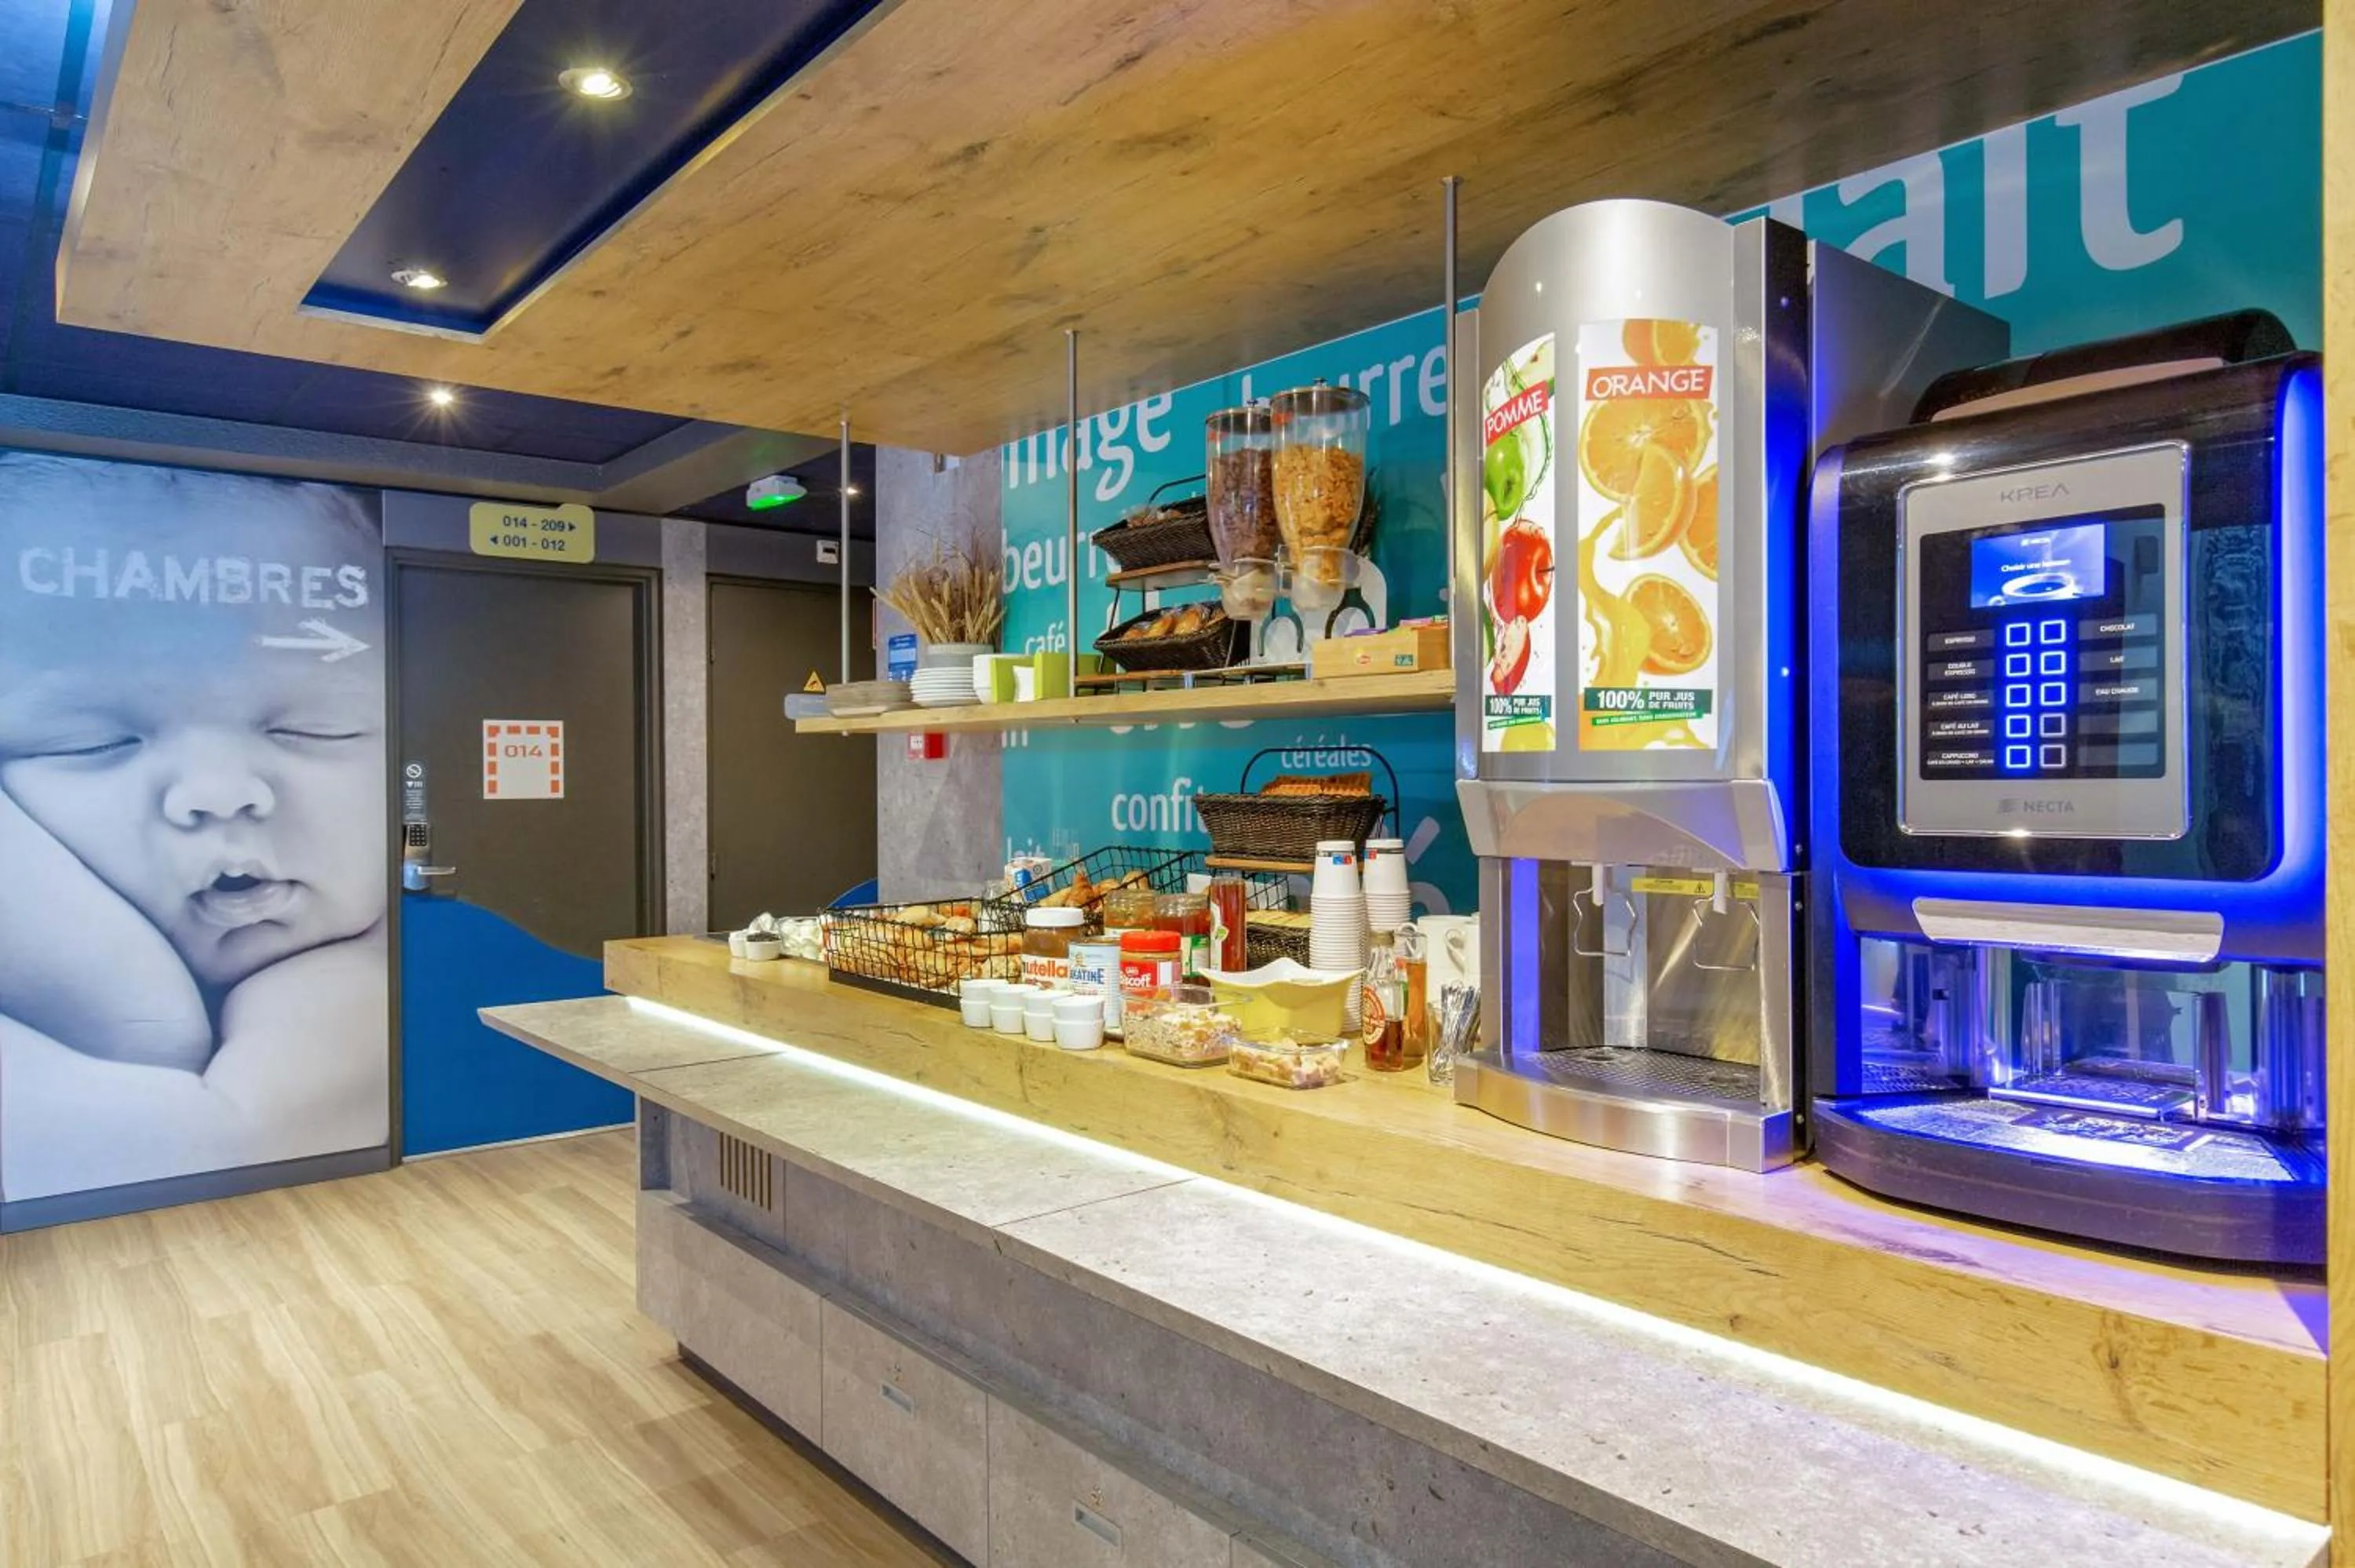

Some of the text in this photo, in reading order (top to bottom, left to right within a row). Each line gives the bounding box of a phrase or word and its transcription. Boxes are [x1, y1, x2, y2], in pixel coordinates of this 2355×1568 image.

[1769, 72, 2184, 299] ait
[1592, 369, 1705, 398] ORANGE
[1487, 389, 1543, 439] POMME
[2001, 483, 2070, 502] KREA
[502, 515, 528, 528] 014
[541, 519, 565, 531] 209
[502, 535, 527, 547] 001
[541, 538, 565, 551] 012
[18, 547, 369, 610] CHAMBRES
[1597, 690, 1695, 709] 100% PUR JUS
[1662, 701, 1695, 709] FRUITS
[505, 745, 543, 758] 014
[1280, 733, 1372, 769] céréales
[2023, 800, 2075, 813] NECTA
